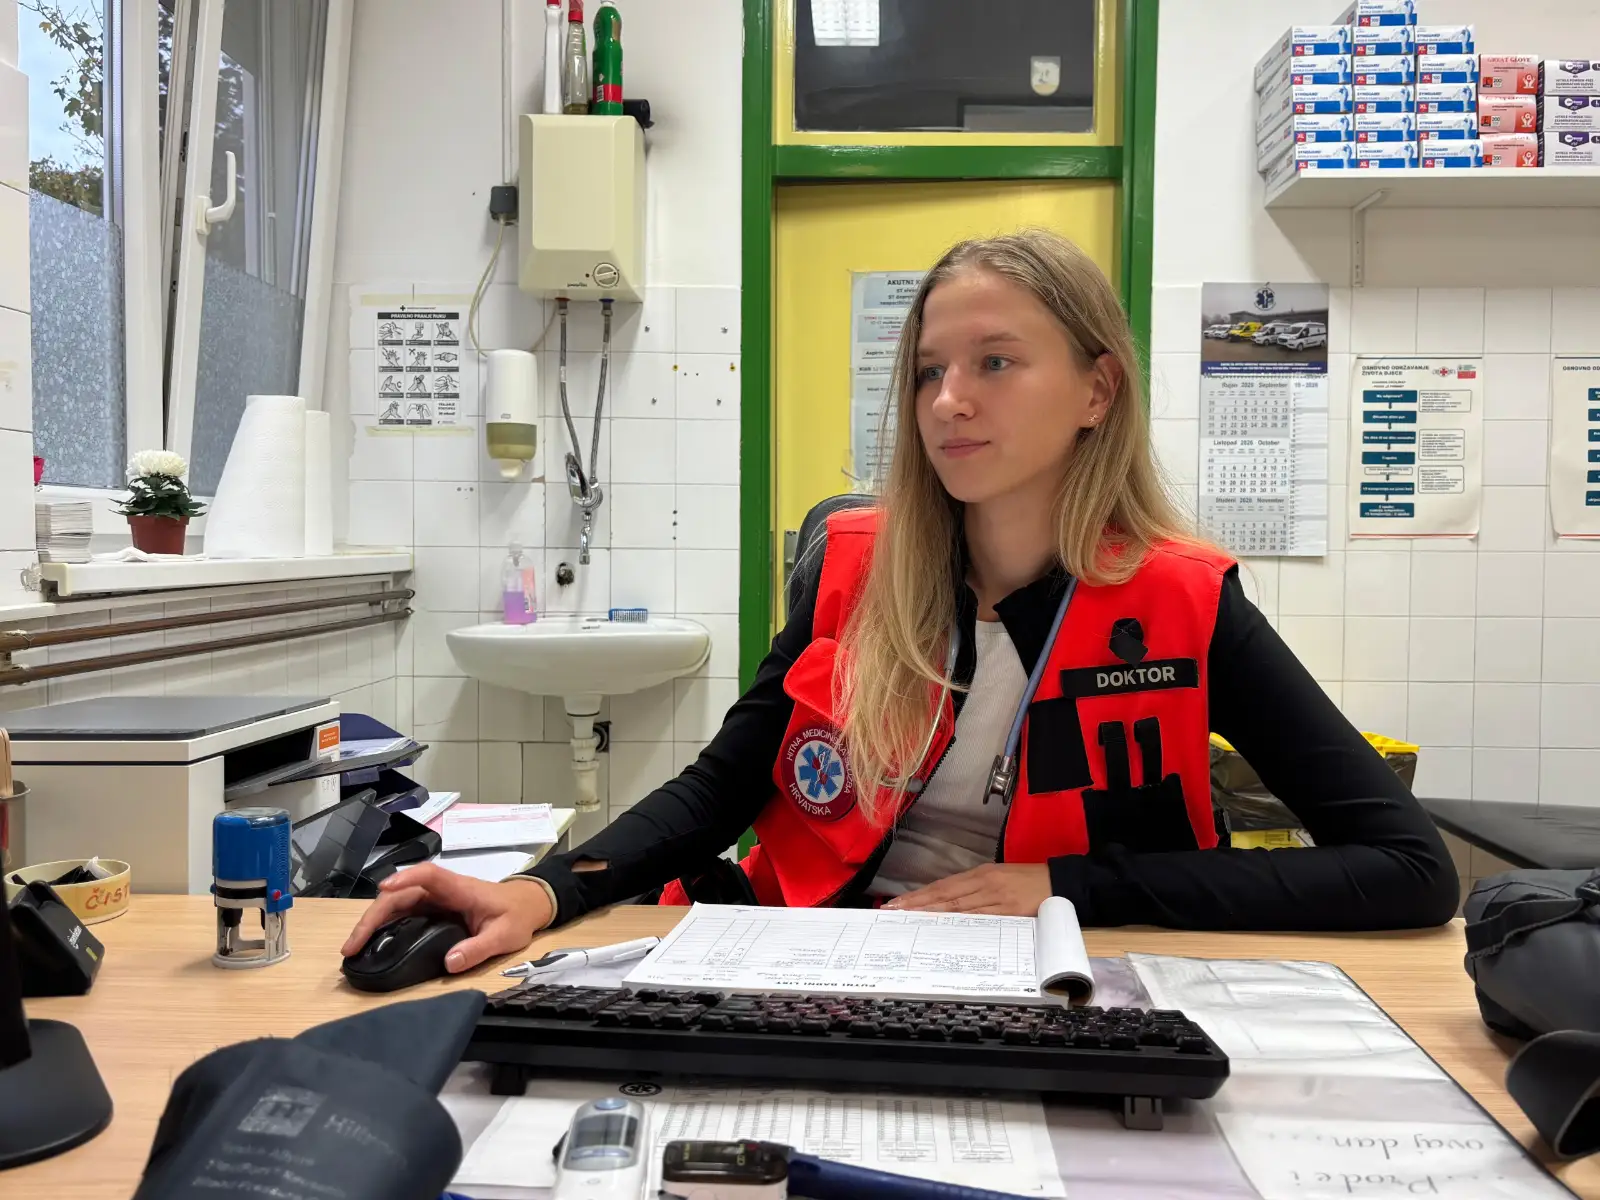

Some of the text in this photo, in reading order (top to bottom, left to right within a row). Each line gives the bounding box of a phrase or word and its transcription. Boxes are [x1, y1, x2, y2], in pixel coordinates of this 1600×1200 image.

[1096, 666, 1175, 688] DOKTOR
[786, 737, 803, 762] HITNA
[789, 782, 831, 816] HRVATSKA
[1334, 1133, 1484, 1160] ovaj dan
